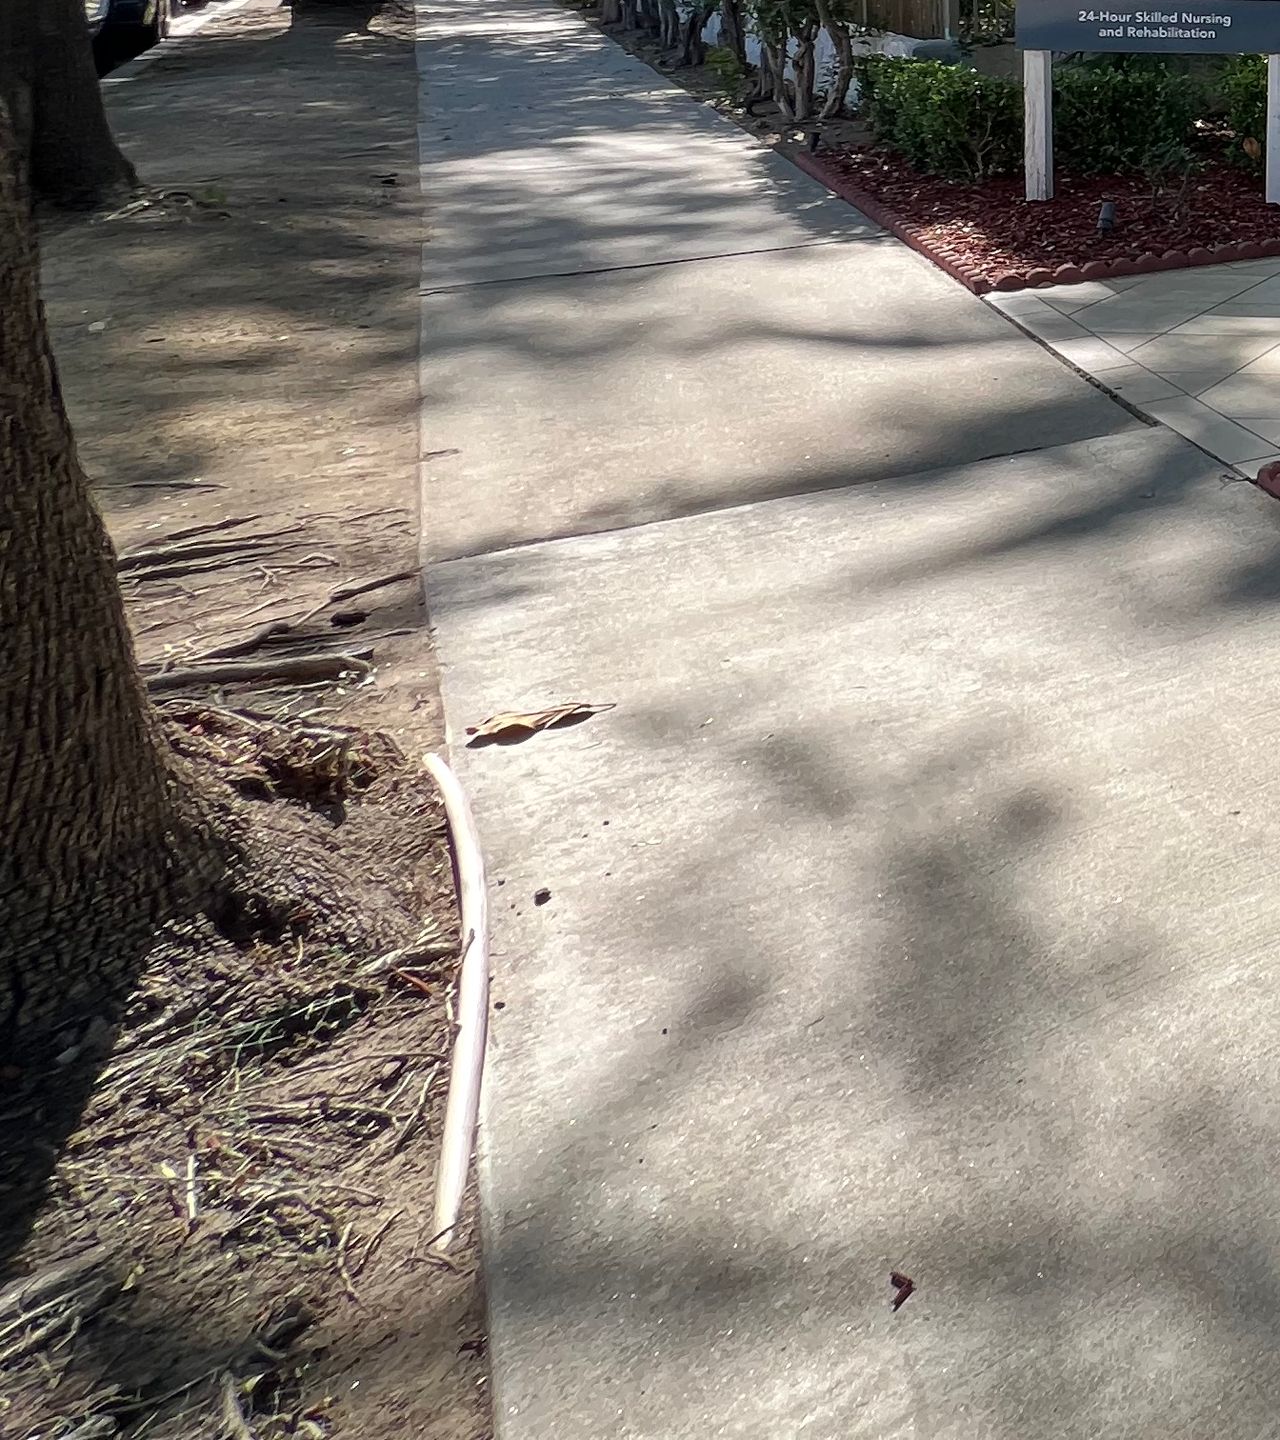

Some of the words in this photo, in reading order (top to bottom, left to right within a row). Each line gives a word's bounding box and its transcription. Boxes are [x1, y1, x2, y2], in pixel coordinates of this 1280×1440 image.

[1078, 11, 1132, 22] 24-Hour
[1135, 11, 1178, 23] Skilled
[1182, 13, 1232, 27] Nursing
[1099, 26, 1123, 37] and
[1127, 26, 1216, 38] Rehabilitation
